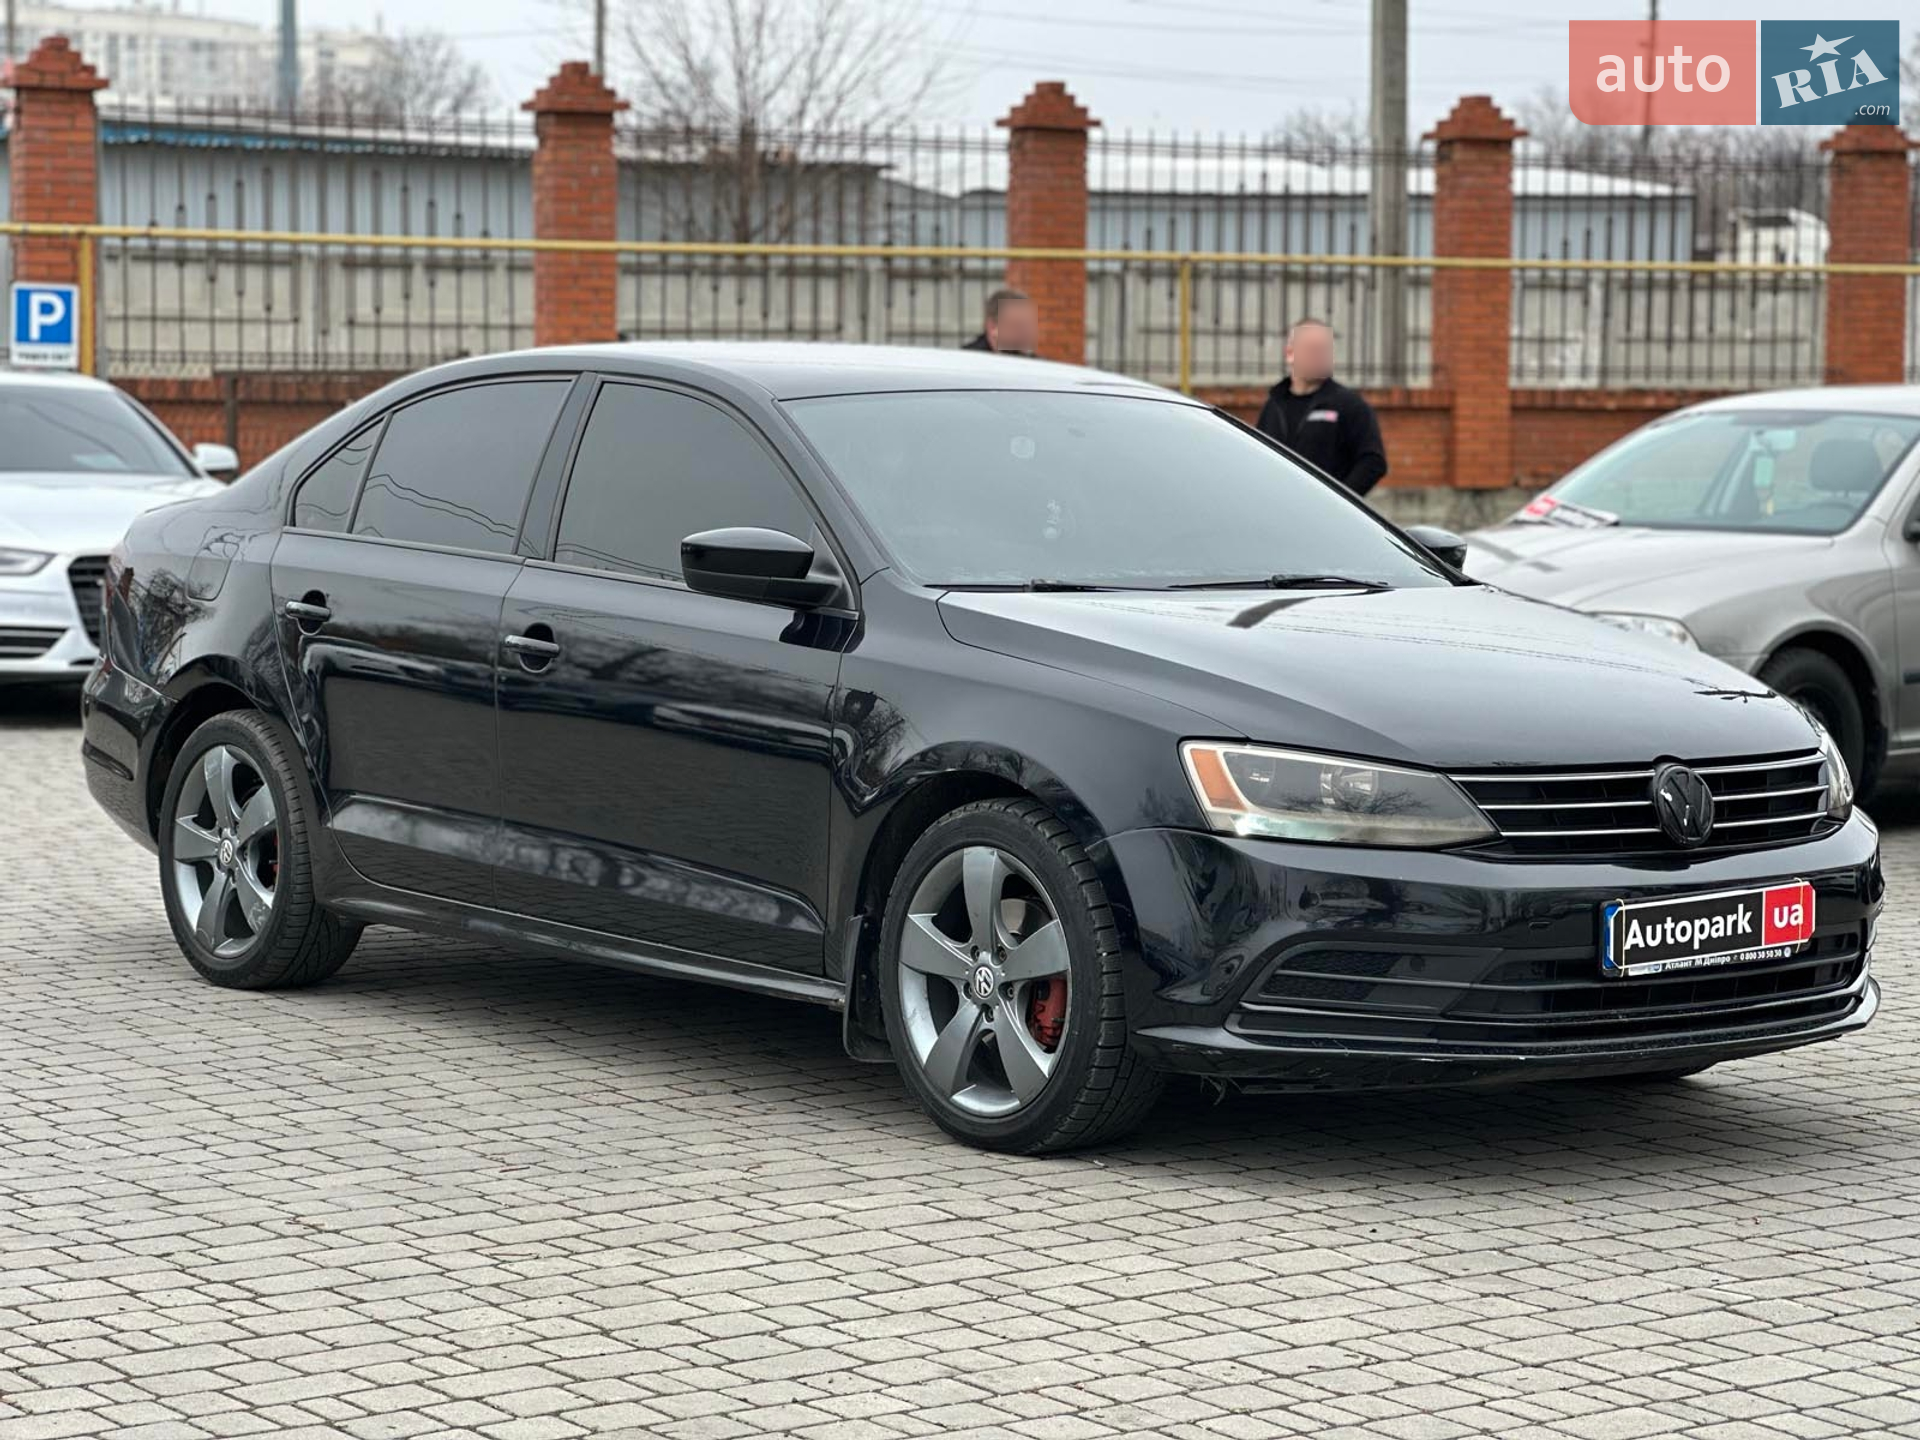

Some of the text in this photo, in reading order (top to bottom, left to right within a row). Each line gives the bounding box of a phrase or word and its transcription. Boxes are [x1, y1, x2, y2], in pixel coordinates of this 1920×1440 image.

[29, 291, 66, 341] P
[1624, 903, 1804, 949] Autopark ua
